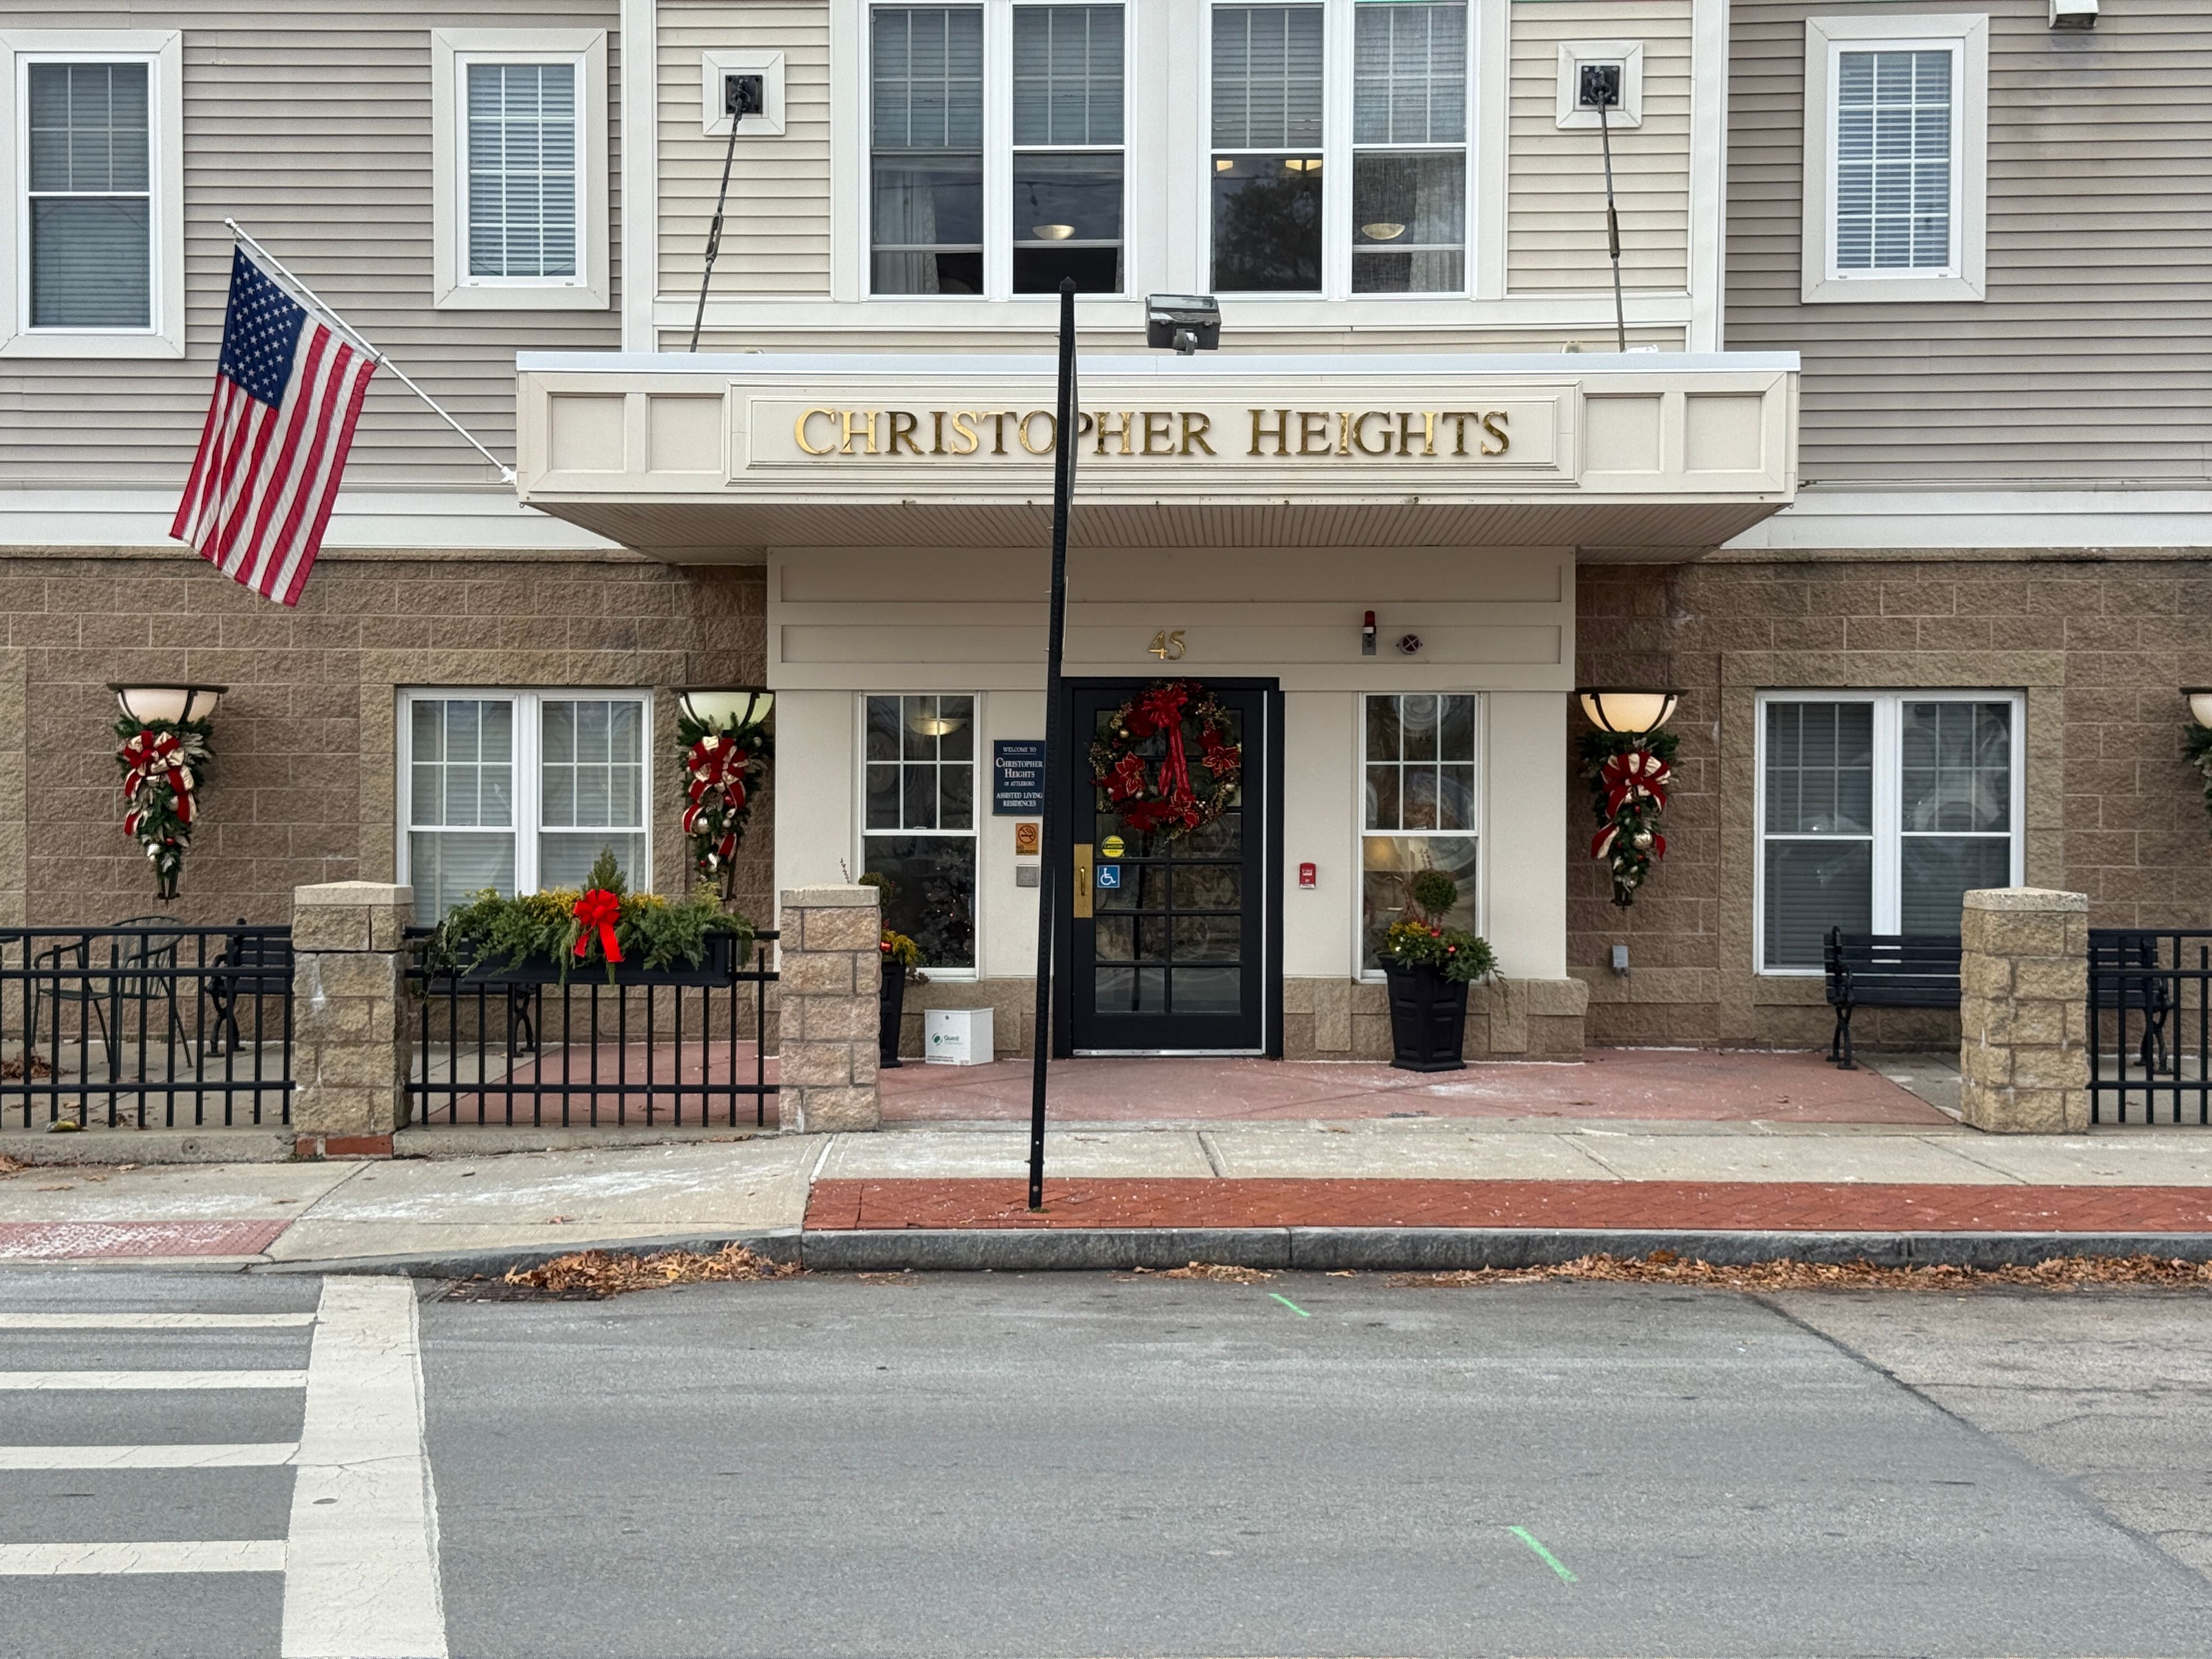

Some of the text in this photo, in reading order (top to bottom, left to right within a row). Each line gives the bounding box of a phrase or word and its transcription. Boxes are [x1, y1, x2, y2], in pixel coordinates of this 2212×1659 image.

[1246, 408, 1510, 456] HEIGHTS
[1147, 630, 1185, 661] 45
[995, 757, 1043, 768] CHRISTOPHER
[1005, 768, 1035, 778] HEIGHTS
